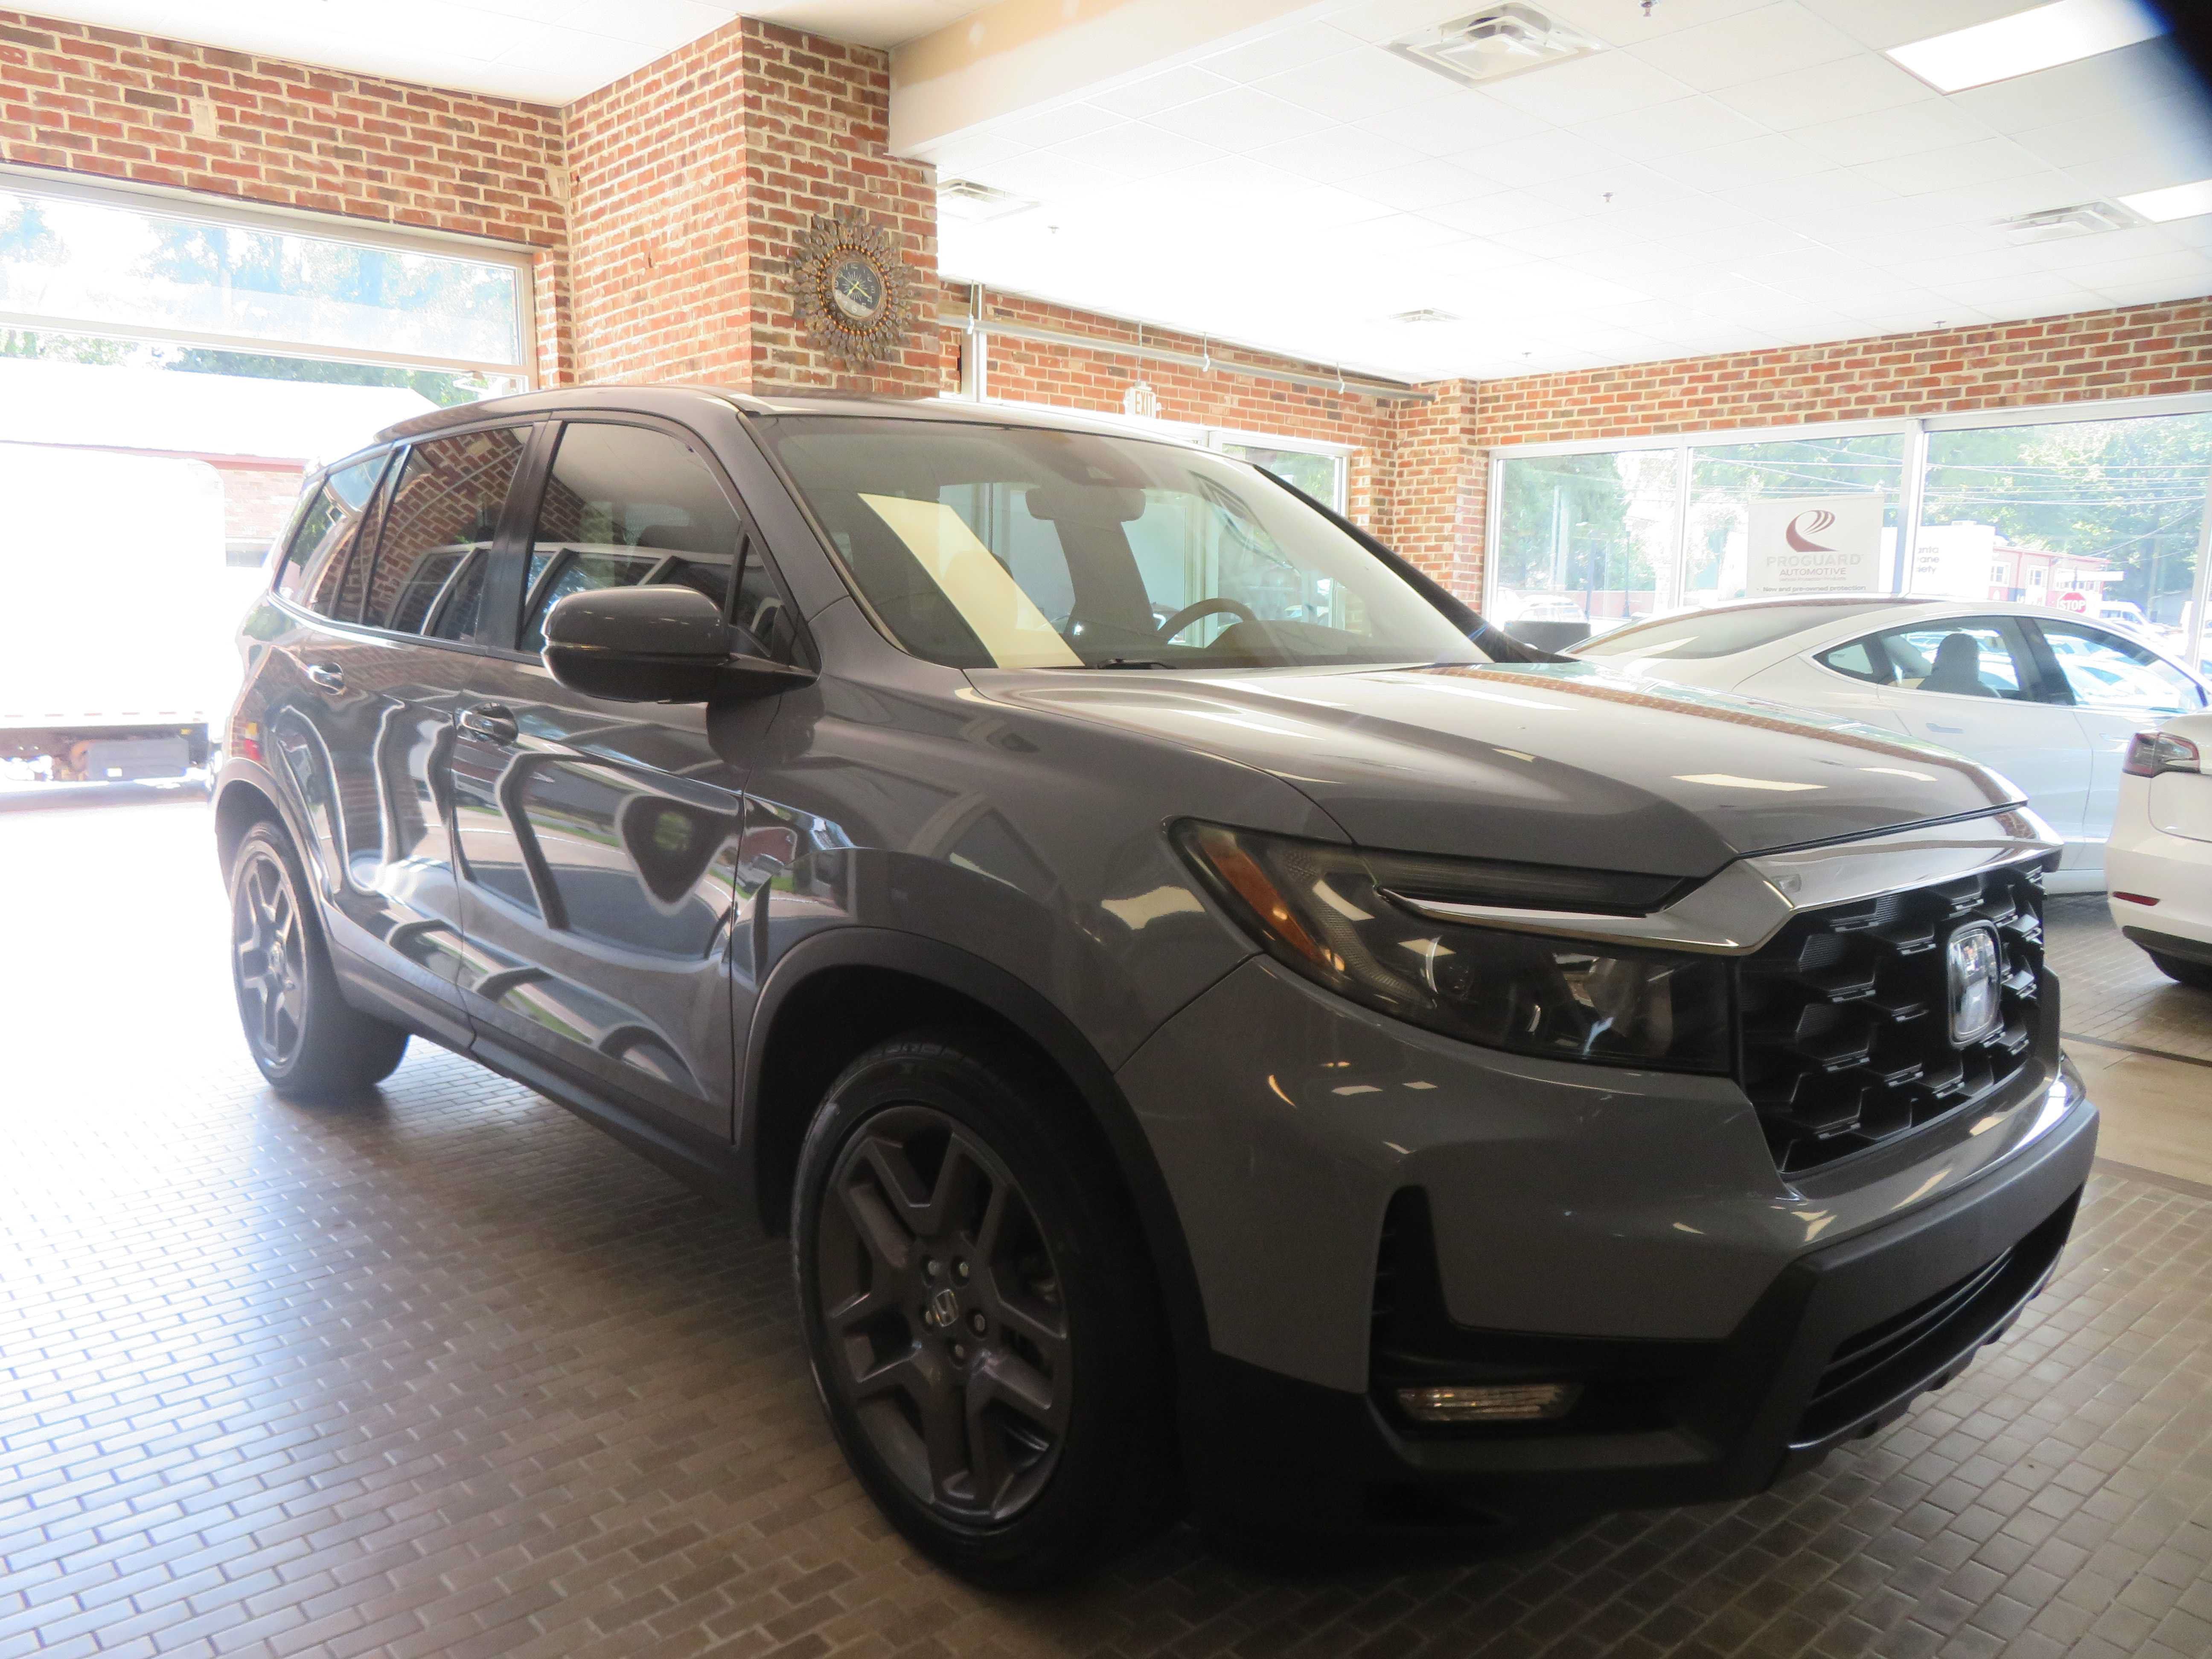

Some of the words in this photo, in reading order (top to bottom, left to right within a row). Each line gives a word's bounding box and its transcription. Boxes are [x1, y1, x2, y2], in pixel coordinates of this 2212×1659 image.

[861, 302, 867, 311] 5
[1135, 390, 1153, 417] EXIT
[1766, 554, 1862, 567] PROGUARD
[1779, 568, 1847, 576] AUTOMOTIVE
[2059, 600, 2086, 610] STOP
